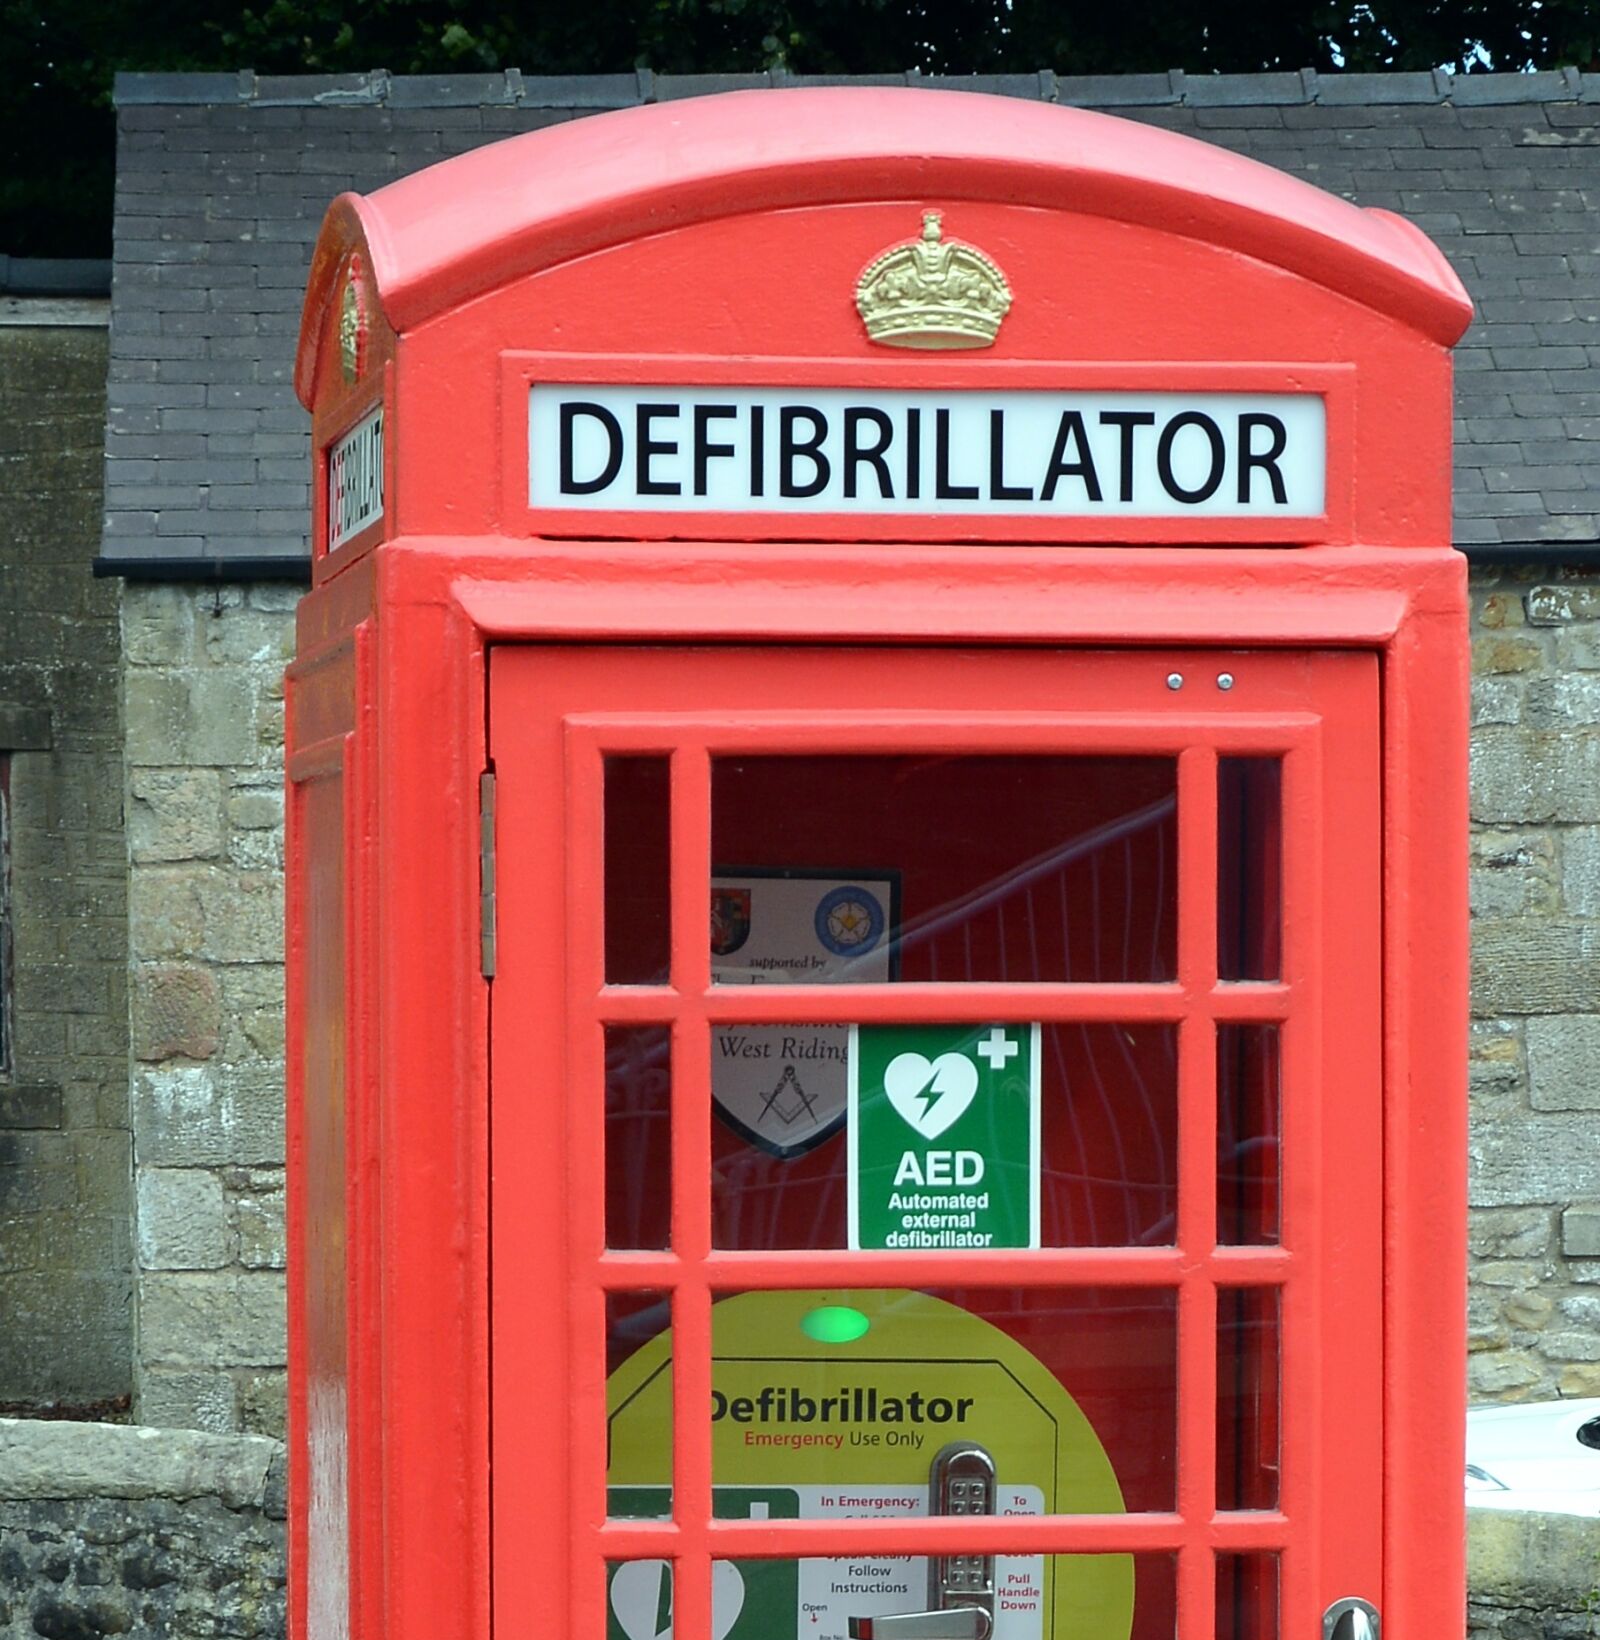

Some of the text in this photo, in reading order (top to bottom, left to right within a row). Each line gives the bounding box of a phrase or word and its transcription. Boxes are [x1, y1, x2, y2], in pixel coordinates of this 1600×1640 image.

[558, 399, 1289, 505] DEFIBRILLATOR
[749, 956, 827, 972] supported by
[719, 1036, 771, 1059] West
[893, 1150, 985, 1187] AED
[887, 1192, 989, 1210] Automated
[901, 1211, 976, 1228] external
[885, 1229, 993, 1248] defibrillator
[711, 1387, 974, 1423] Defibrillator
[744, 1431, 925, 1450] Emergency Use Only
[821, 1495, 920, 1510] In Emergency:
[1012, 1495, 1027, 1506] To
[848, 1565, 892, 1577] Follow
[1007, 1574, 1031, 1584] Pull
[830, 1582, 909, 1594] Instructions
[997, 1587, 1040, 1598] Handle
[802, 1603, 828, 1613] Open
[1000, 1600, 1037, 1611] Down
